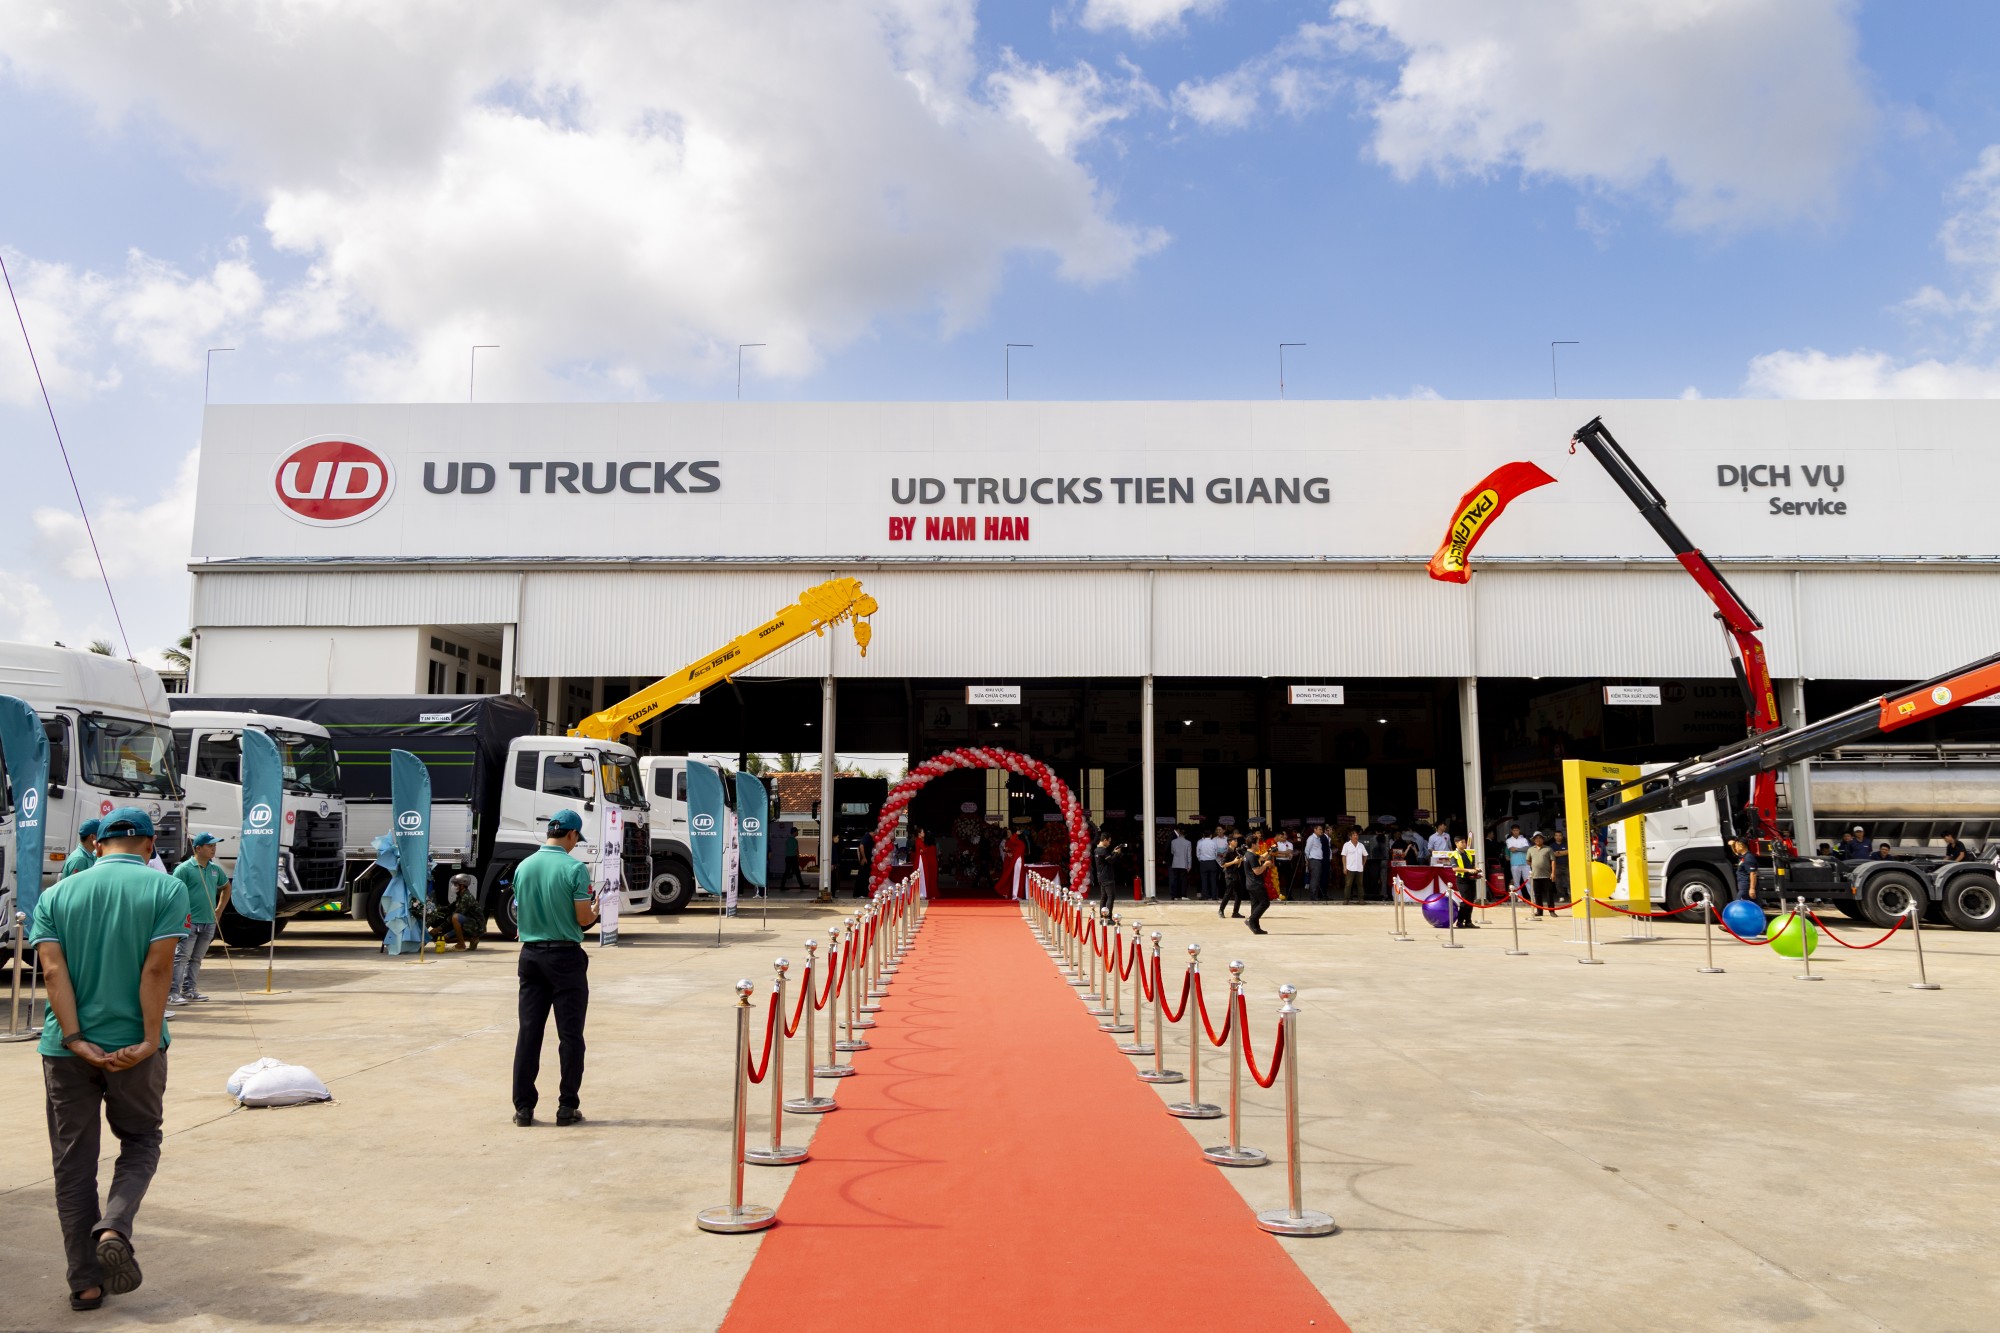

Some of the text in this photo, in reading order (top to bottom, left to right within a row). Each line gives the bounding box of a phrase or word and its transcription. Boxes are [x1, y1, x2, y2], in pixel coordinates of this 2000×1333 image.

[280, 461, 383, 500] UD
[423, 460, 721, 495] UD TRUCKS
[1717, 464, 1845, 493] DỊCH VỤ
[891, 477, 1331, 505] UD TRUCKS TIEN GIANG
[1769, 497, 1847, 516] Service
[889, 516, 1030, 541] BY NAM HAN
[758, 620, 785, 639] SOOSAN
[711, 651, 735, 669] 1516
[627, 701, 659, 724] SOOSAN
[24, 796, 37, 810] UD
[252, 810, 270, 821] UD
[401, 815, 420, 825] UD
[694, 817, 713, 827] UD
[744, 821, 759, 829] UD
